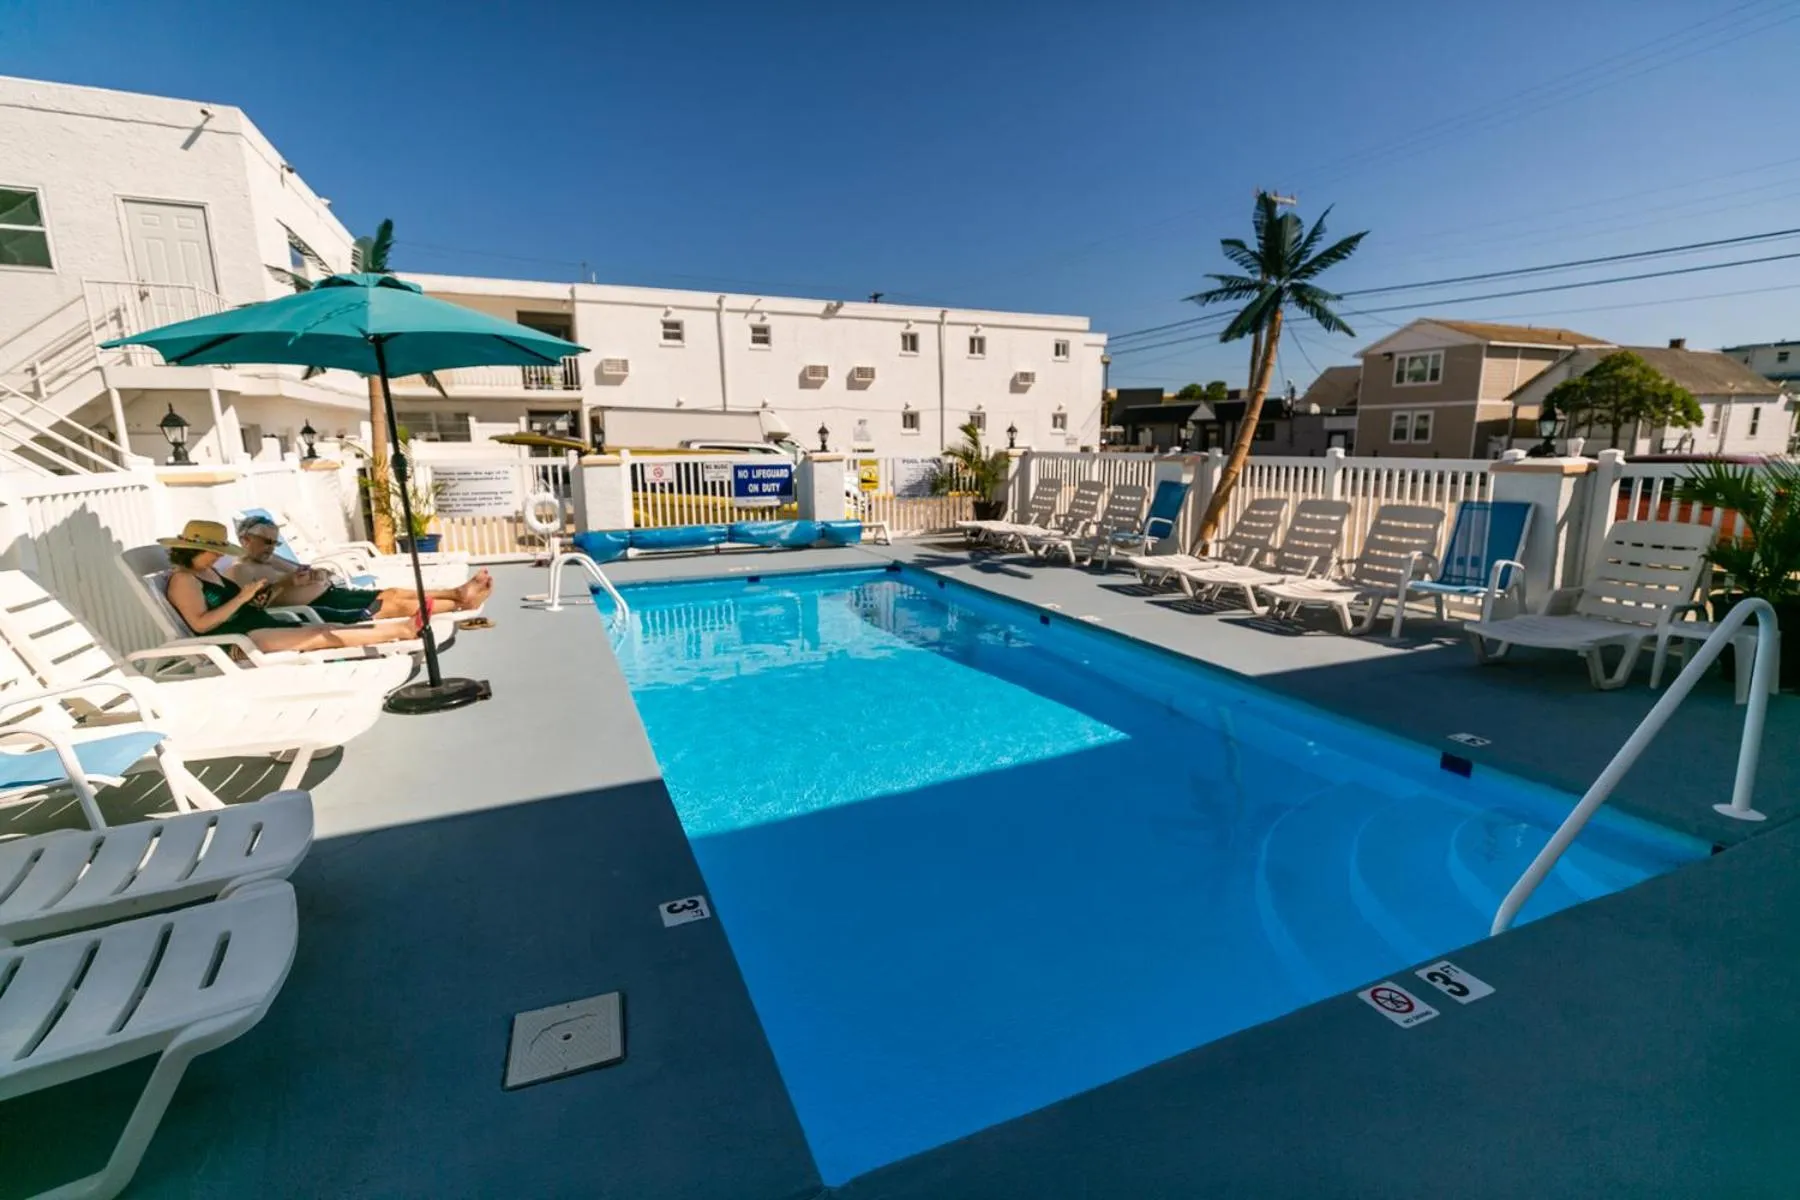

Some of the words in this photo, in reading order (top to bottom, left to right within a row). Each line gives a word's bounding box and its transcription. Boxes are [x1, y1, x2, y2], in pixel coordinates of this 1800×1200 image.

[737, 469, 748, 479] NO
[751, 468, 789, 479] LIFEGUARD
[748, 483, 759, 493] ON
[761, 482, 780, 493] DUTY
[666, 899, 699, 914] 3
[1426, 971, 1470, 997] 3
